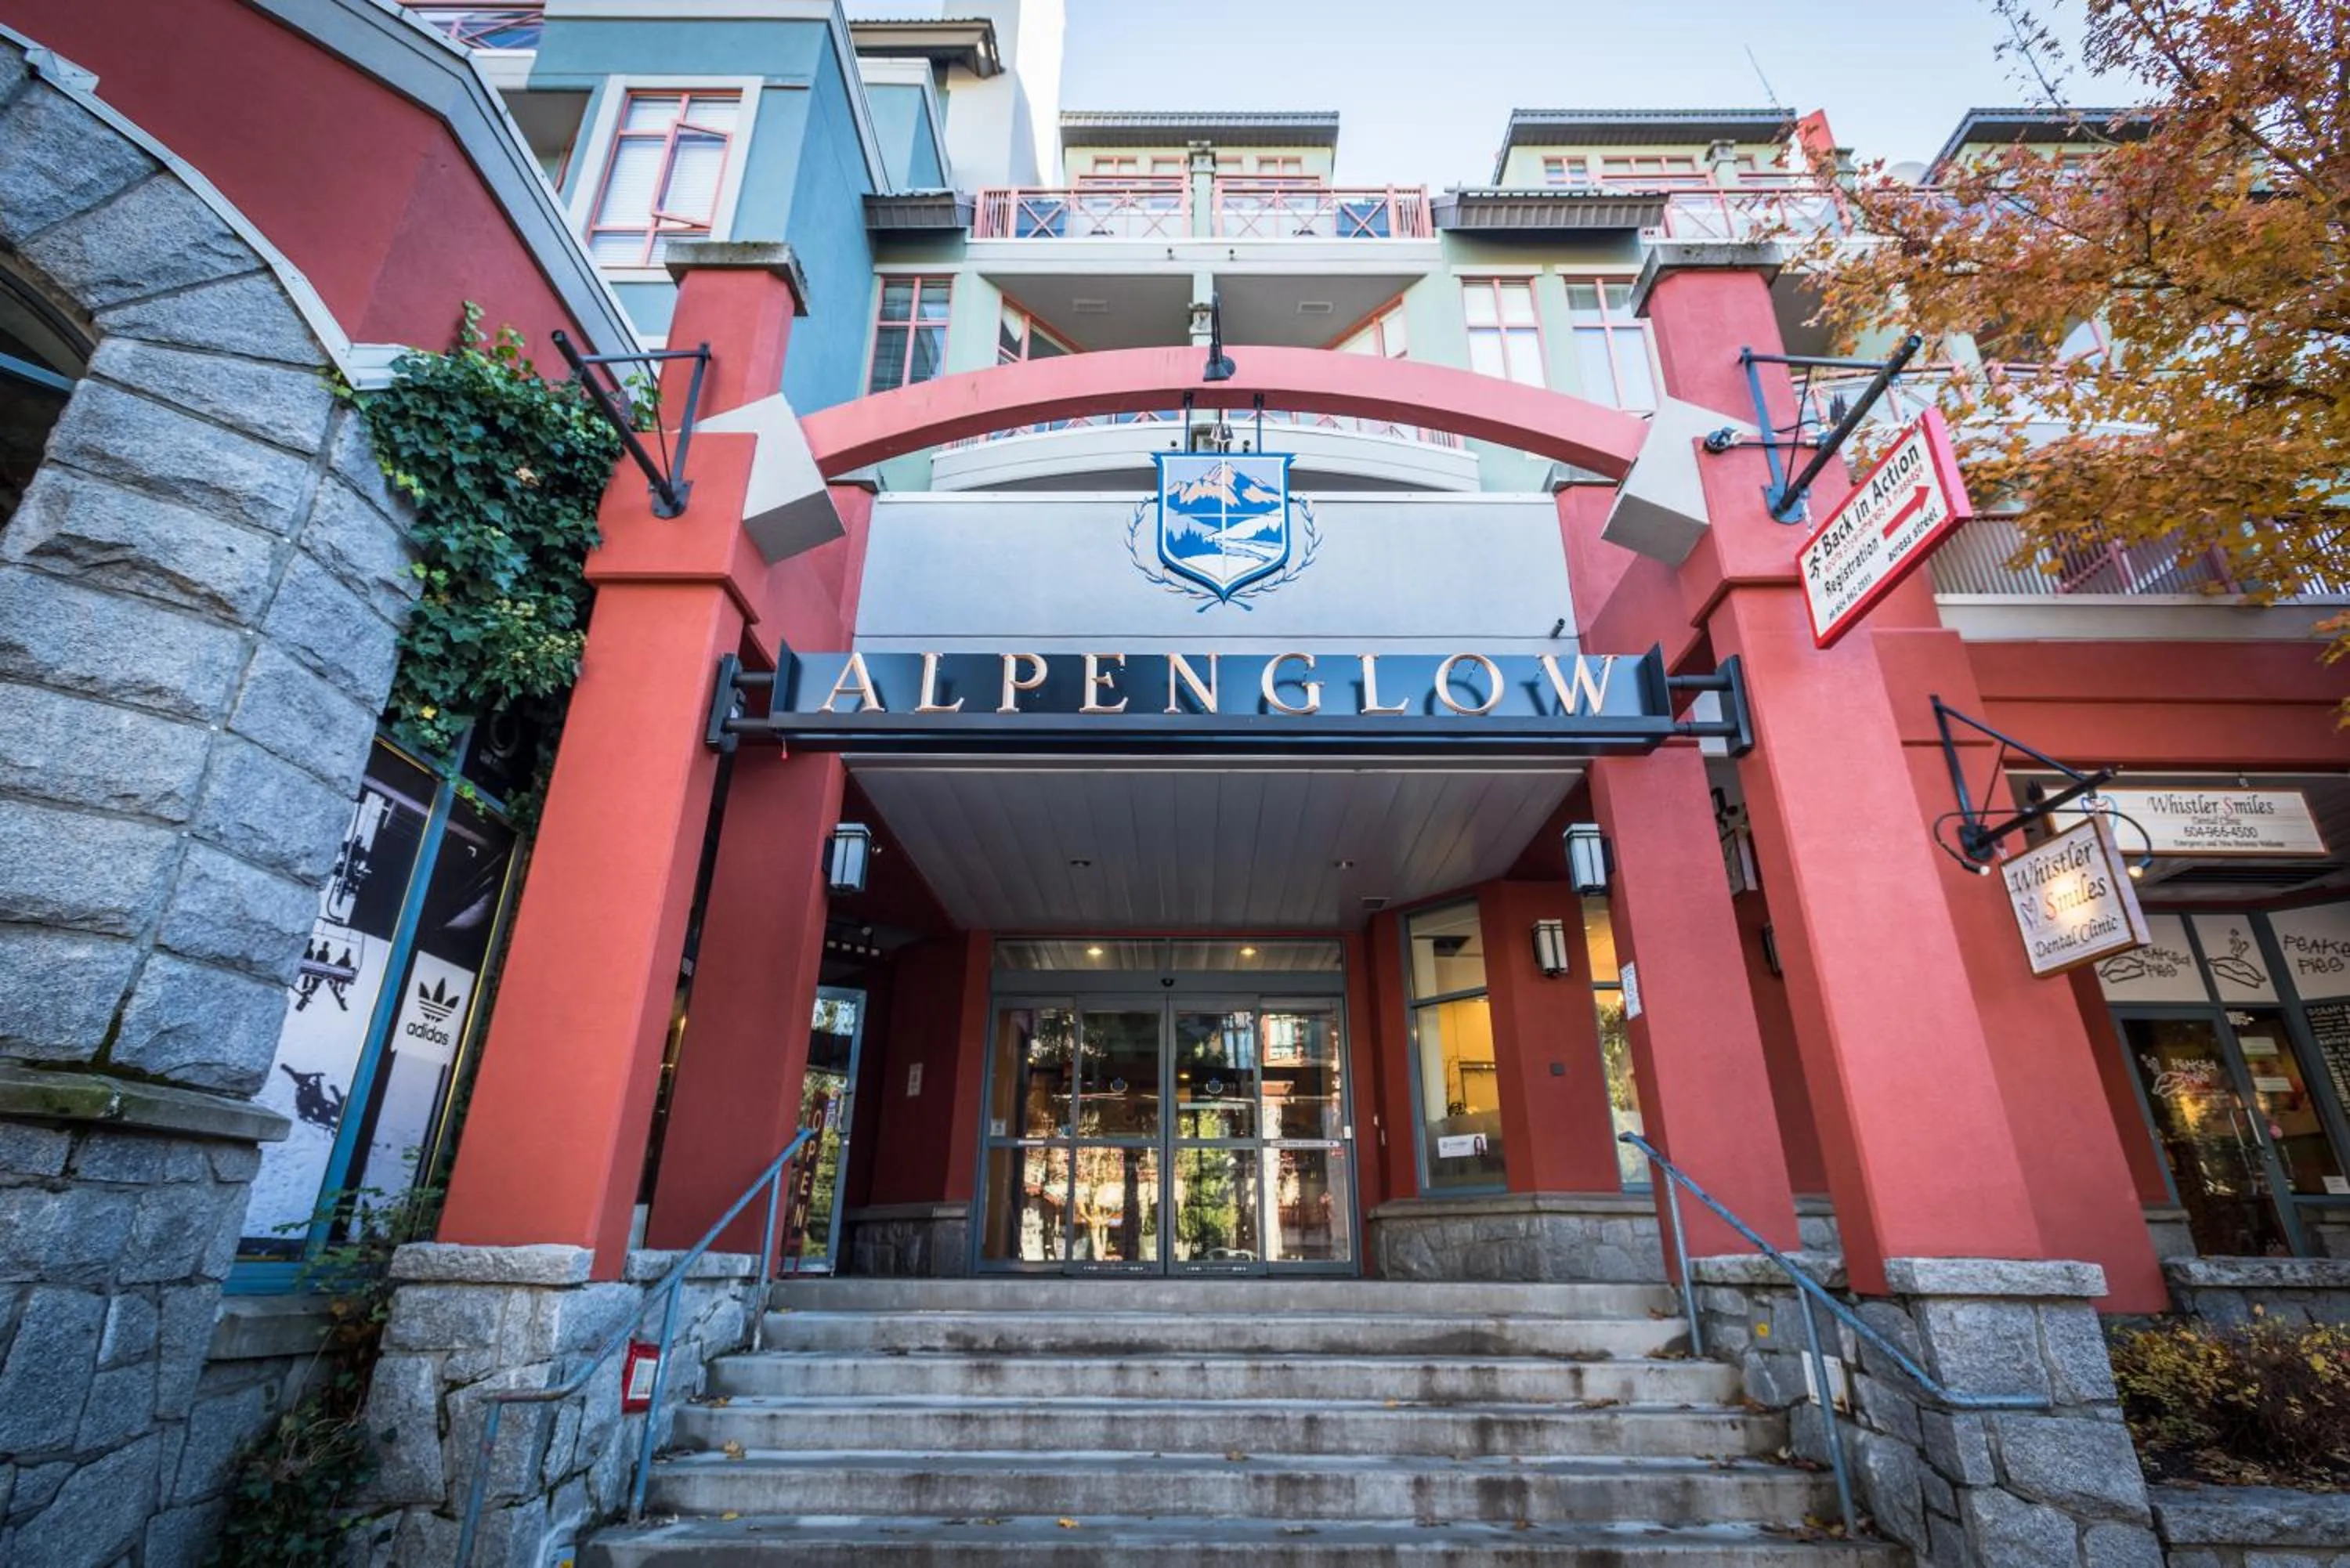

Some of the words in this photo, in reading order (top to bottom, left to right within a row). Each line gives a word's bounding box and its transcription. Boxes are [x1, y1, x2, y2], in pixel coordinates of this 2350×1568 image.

[1821, 513, 1853, 557] Back
[1853, 498, 1870, 523] in
[1872, 443, 1921, 505] Action
[1888, 533, 1912, 562] across
[1913, 506, 1938, 538] street
[1824, 537, 1879, 598] Registration
[817, 651, 1619, 716] ALPENGLOW
[2147, 793, 2219, 816] Whistler
[2221, 794, 2275, 817] Smiles
[2011, 840, 2093, 893] Whistler
[2044, 873, 2107, 920] Smiles
[2035, 925, 2080, 957] Dental
[2079, 914, 2118, 943] Clinic
[407, 1022, 450, 1046] adidas
[794, 1109, 822, 1228] OPEN
